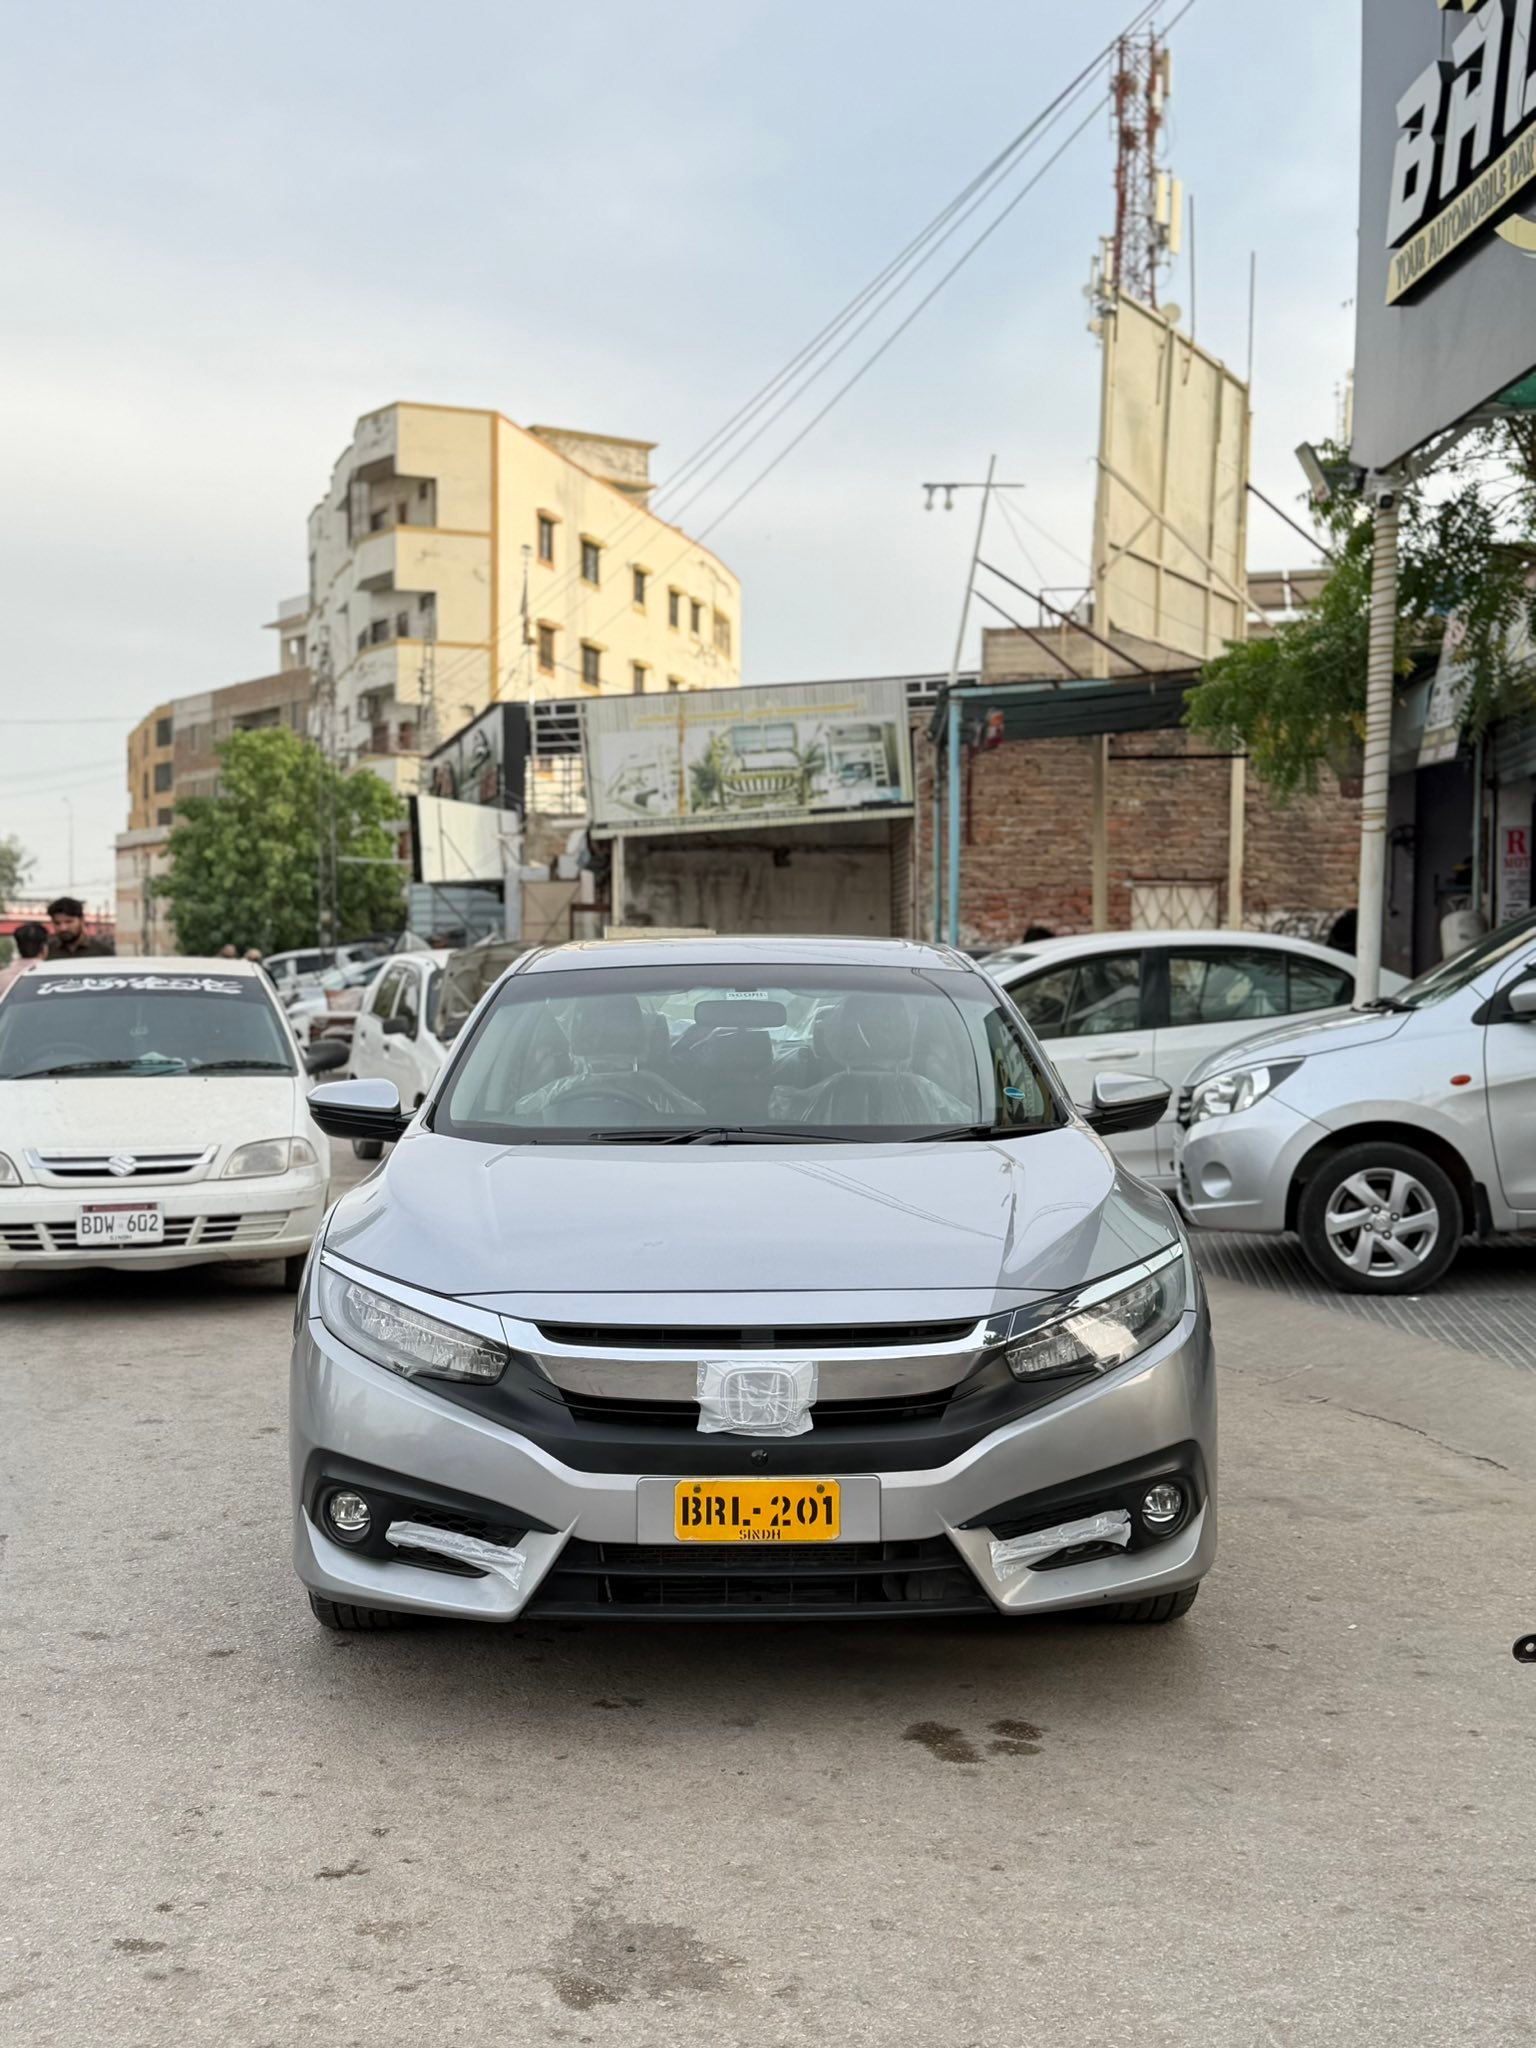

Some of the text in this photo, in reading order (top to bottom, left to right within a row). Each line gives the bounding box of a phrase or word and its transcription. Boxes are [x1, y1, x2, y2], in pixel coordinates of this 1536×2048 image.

[1396, 127, 1536, 289] YOUR AUTOMOBILE PAR
[81, 1214, 158, 1234] BDW 602
[682, 1495, 833, 1526] BRL-201
[739, 1529, 781, 1540] SINDH
